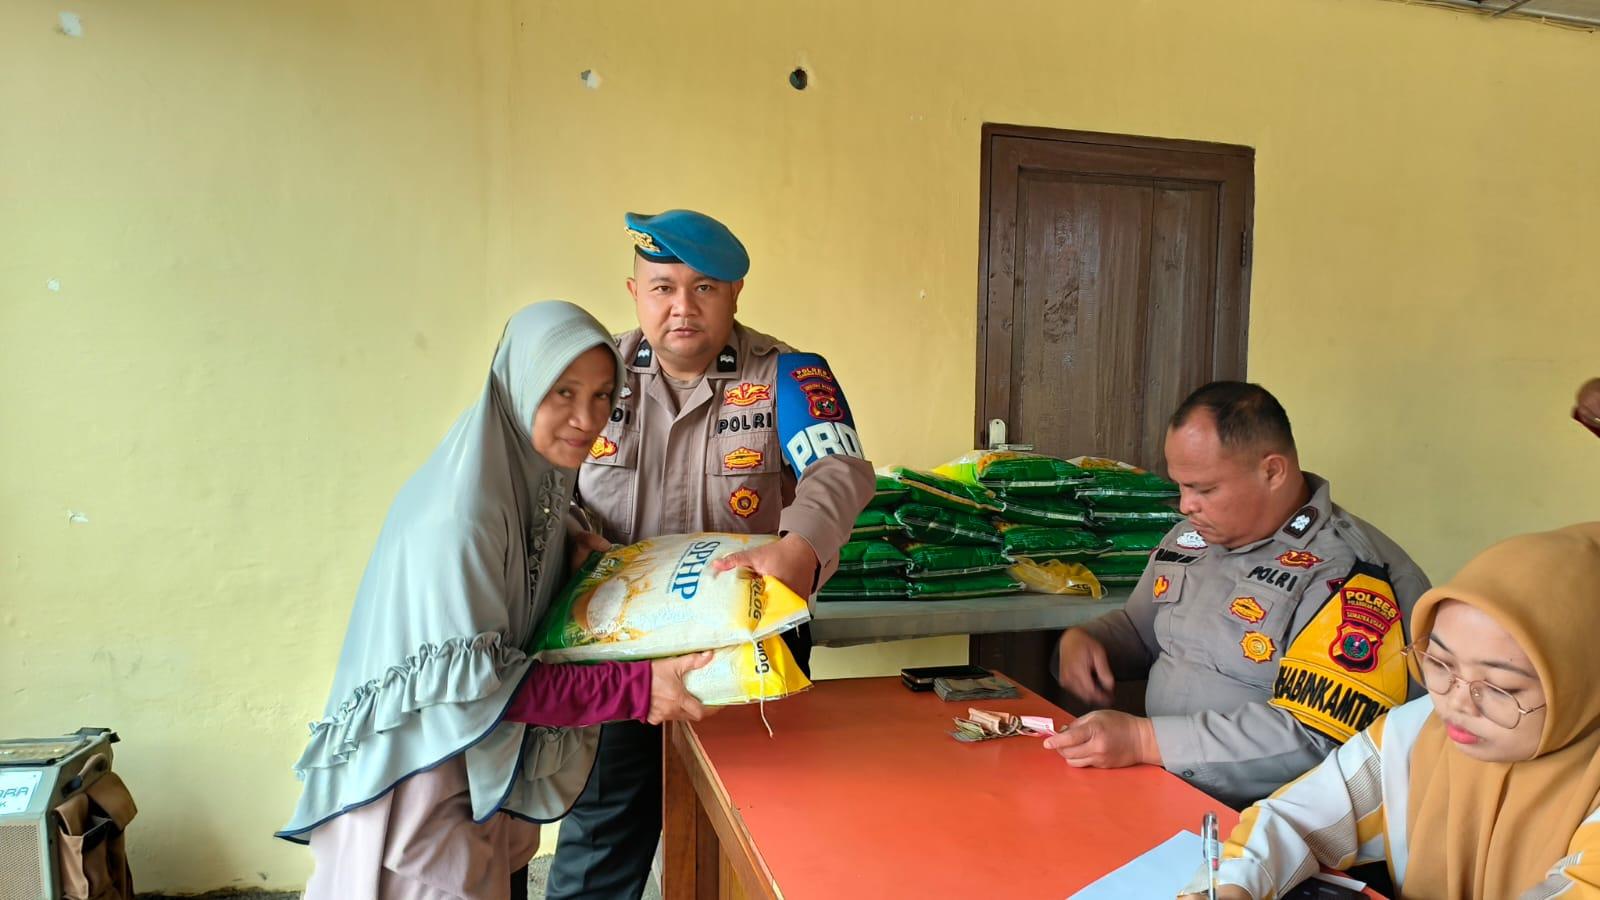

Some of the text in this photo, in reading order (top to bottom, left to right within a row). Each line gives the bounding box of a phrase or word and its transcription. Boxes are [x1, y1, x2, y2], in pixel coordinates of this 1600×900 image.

[716, 411, 773, 434] POLRI
[671, 541, 721, 600] SPHP
[1247, 564, 1299, 593] POLRI
[1345, 591, 1398, 618] POLRES
